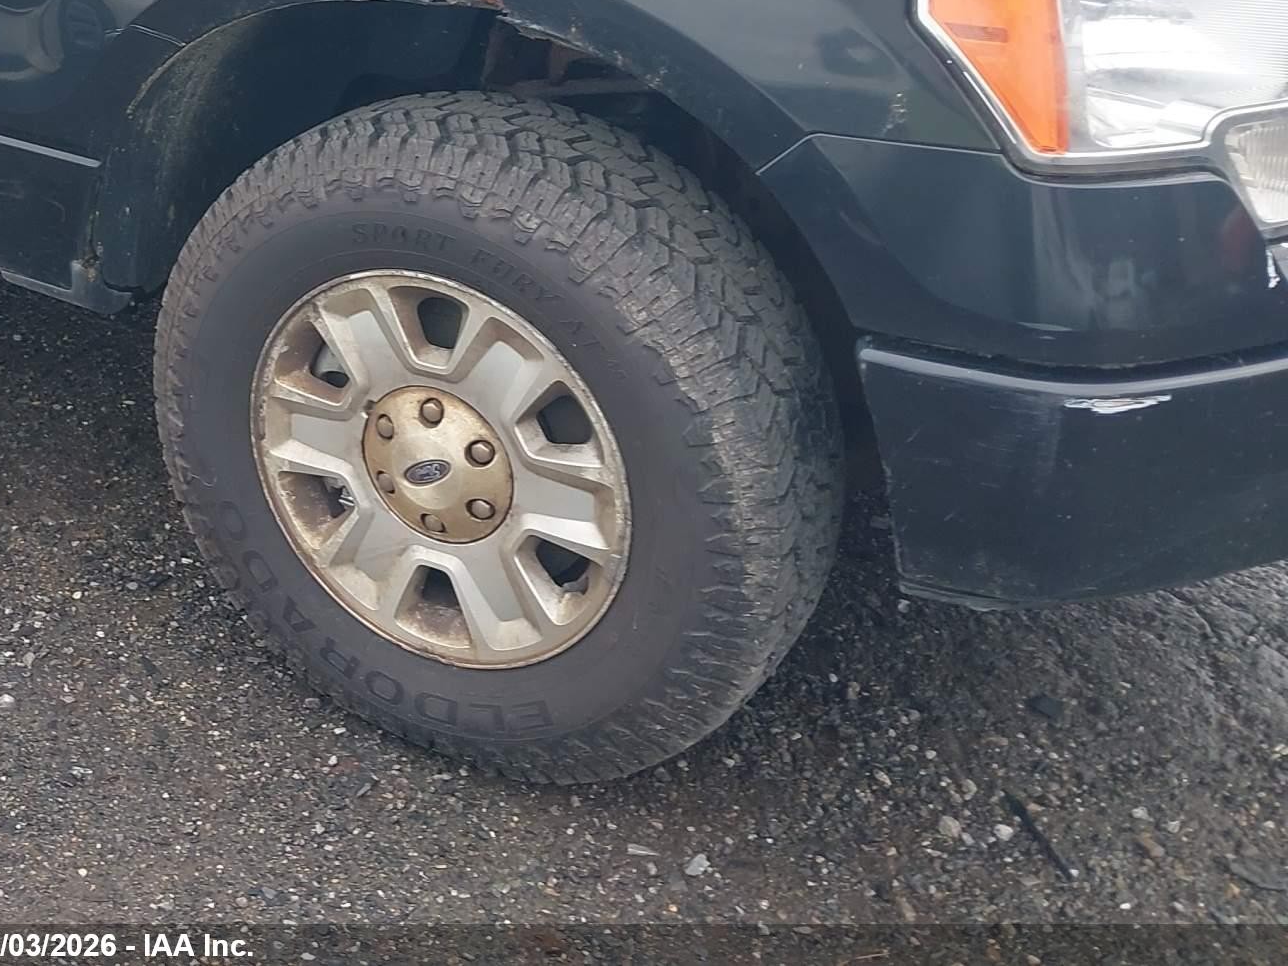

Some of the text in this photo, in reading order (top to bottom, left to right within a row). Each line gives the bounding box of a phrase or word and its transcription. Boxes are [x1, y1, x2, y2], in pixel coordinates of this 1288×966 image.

[352, 222, 565, 301] SPORT FURY
[216, 500, 555, 734] ELDORADO
